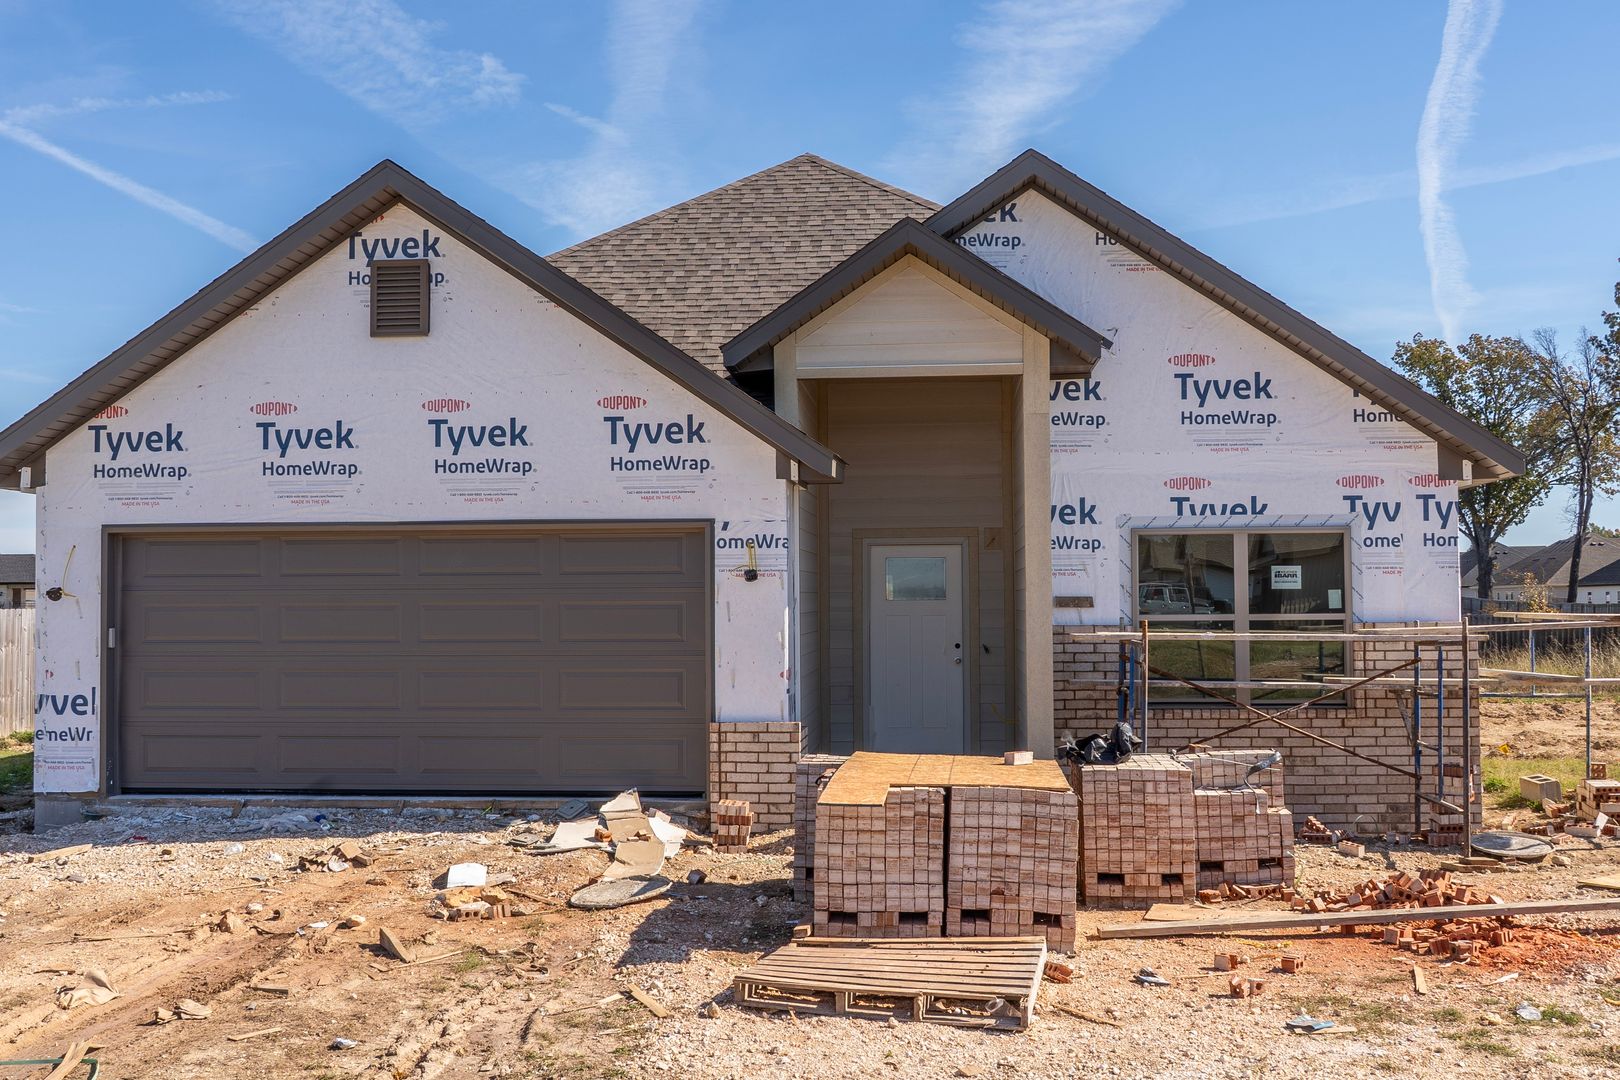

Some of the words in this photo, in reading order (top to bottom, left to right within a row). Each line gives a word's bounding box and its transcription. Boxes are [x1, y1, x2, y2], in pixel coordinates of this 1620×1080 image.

[348, 229, 441, 267] Tyvek
[1173, 354, 1211, 367] DUPONT
[1173, 371, 1273, 408] Tyvek
[255, 401, 293, 416] DUPONT
[427, 399, 465, 413] DUPONT
[602, 395, 641, 410] DUPONT
[1051, 411, 1106, 429] eWrap
[1181, 410, 1276, 427] HomeWrap
[87, 422, 185, 461] Tyvek
[255, 419, 355, 459] Tyvek
[427, 416, 529, 456] Tyvek
[604, 413, 706, 454] Tyvek
[93, 463, 188, 481] HomeWrap
[262, 461, 358, 479] HomeWrap
[434, 458, 533, 476] HomeWrap
[610, 455, 710, 474] HomeWrap
[1169, 477, 1207, 491] DUPONT
[1341, 474, 1380, 488] DUPONT
